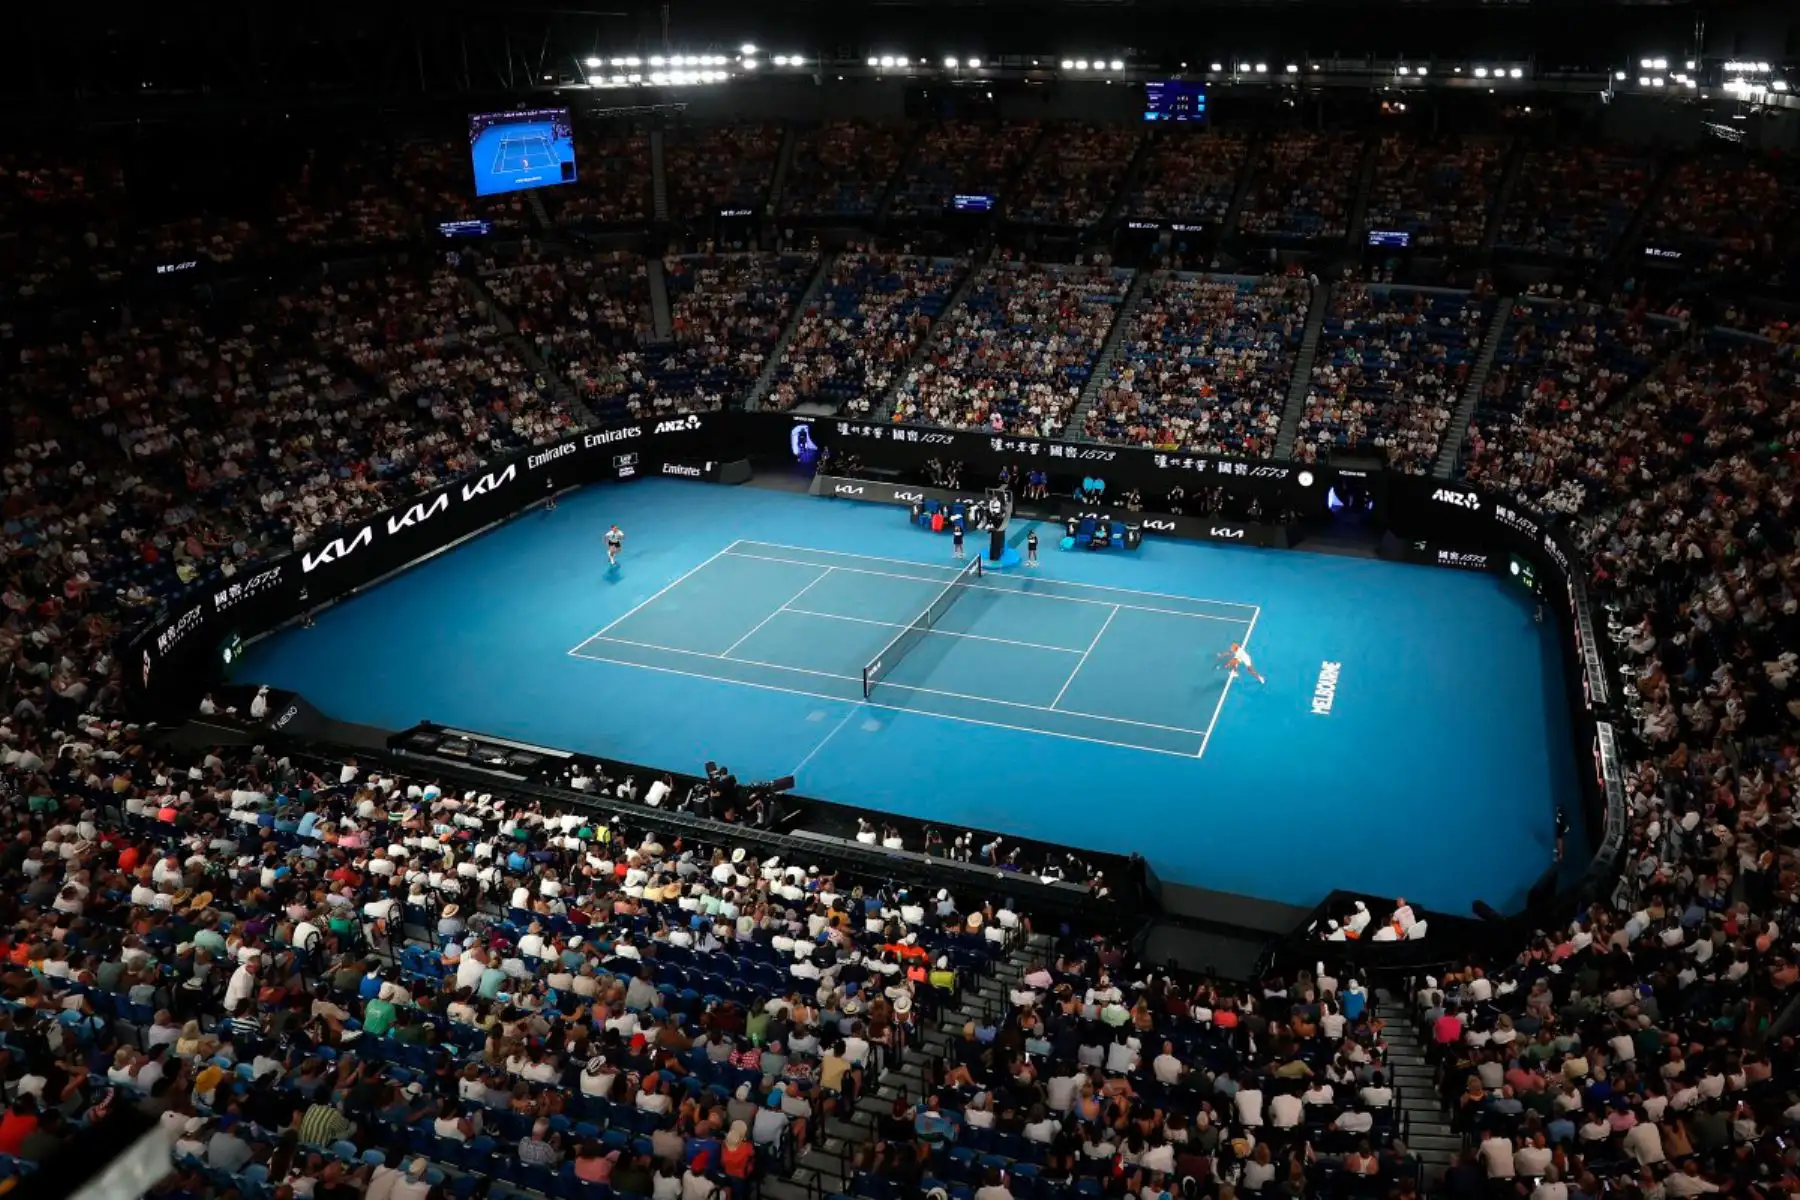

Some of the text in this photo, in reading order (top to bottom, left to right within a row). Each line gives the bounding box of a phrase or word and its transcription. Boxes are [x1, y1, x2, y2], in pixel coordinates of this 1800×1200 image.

[584, 425, 641, 448] Emirates
[654, 420, 685, 434] ANZ
[527, 441, 576, 470] Emirates
[662, 462, 700, 476] Emirates
[1432, 489, 1465, 506] ANZ
[1311, 660, 1341, 715] MELBOURNE
